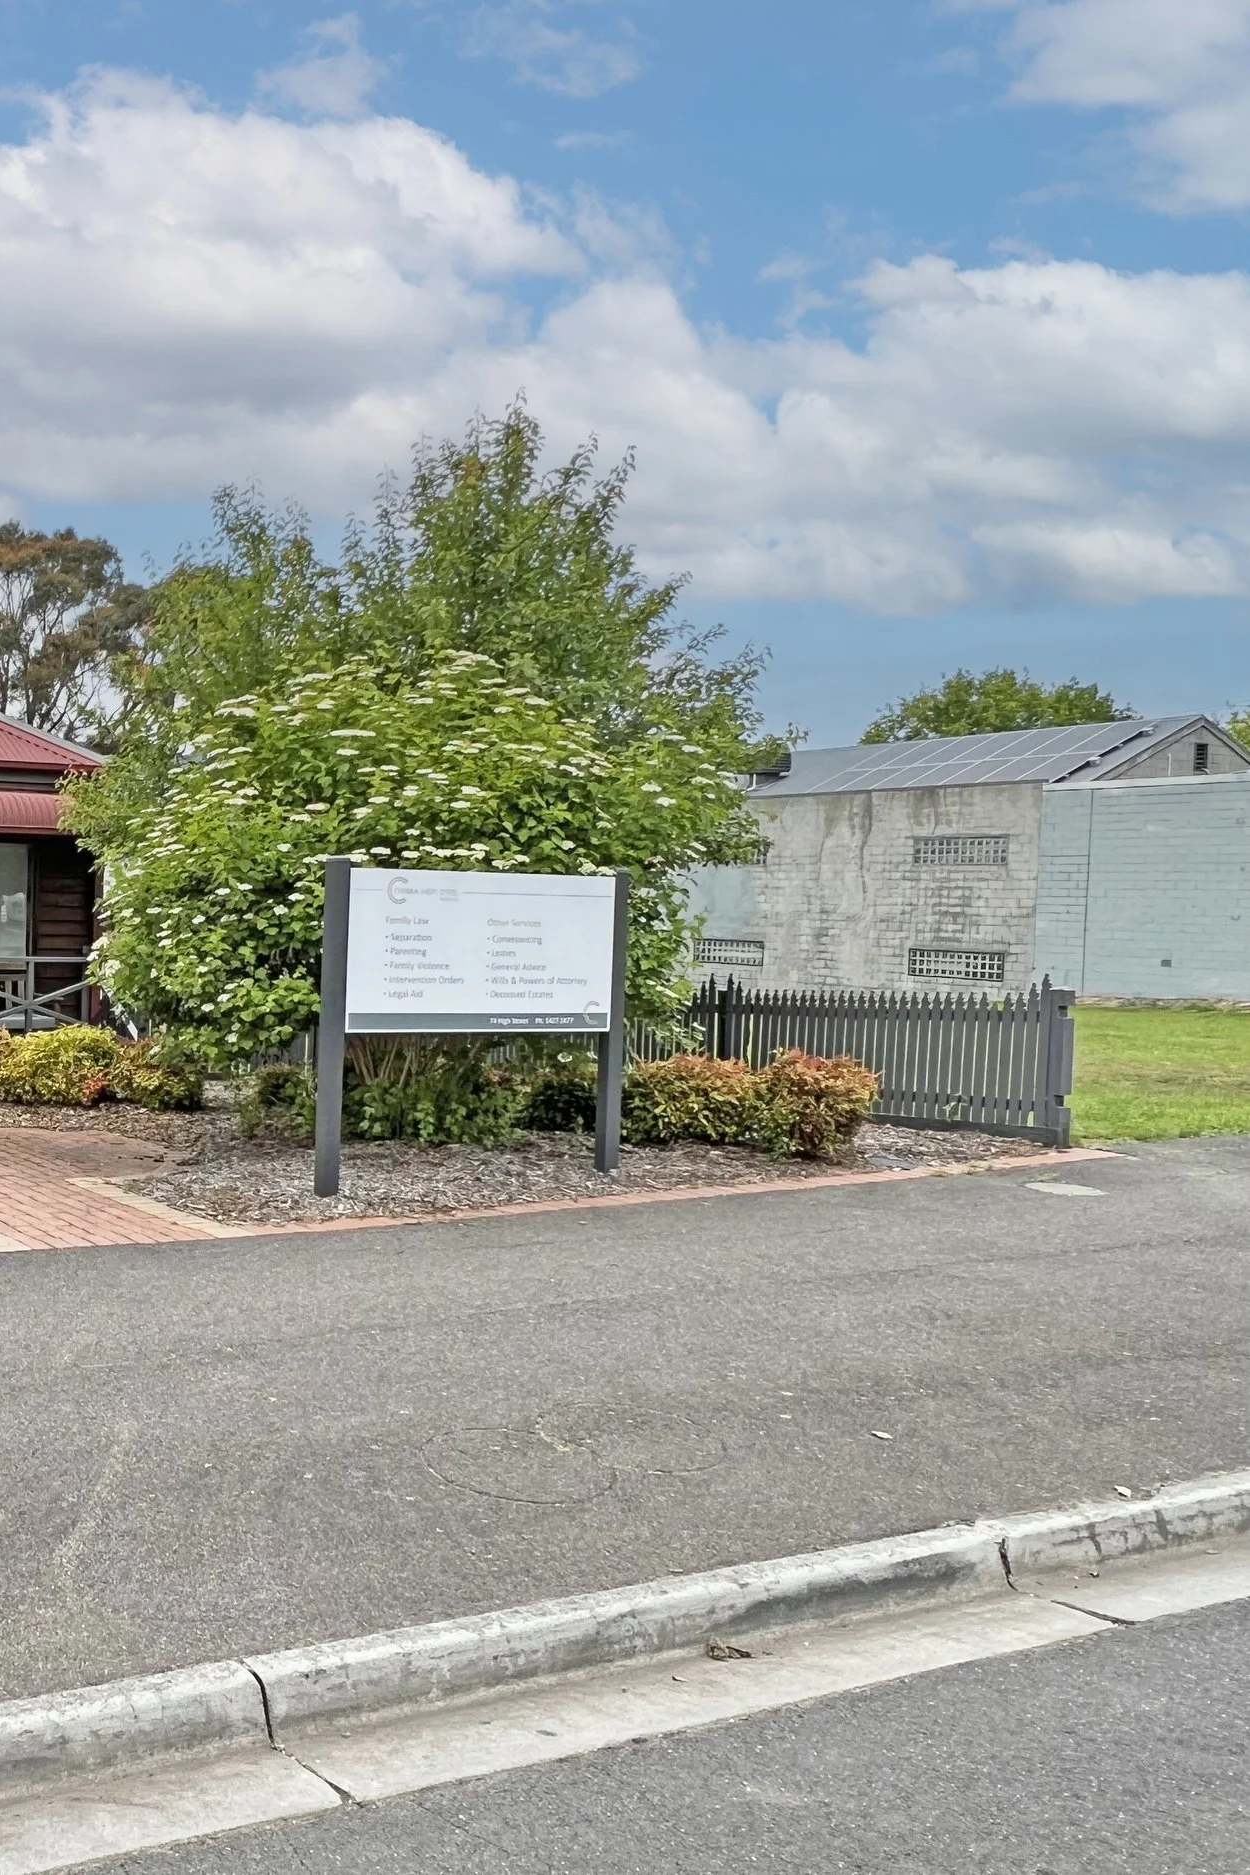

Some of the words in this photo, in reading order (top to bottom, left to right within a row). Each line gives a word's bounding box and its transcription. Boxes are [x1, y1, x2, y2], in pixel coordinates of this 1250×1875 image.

[413, 917, 430, 925] Law
[390, 933, 433, 942] Separation
[390, 947, 427, 958] Parenting
[389, 961, 415, 971] Family
[417, 962, 450, 970] Violence
[491, 963, 520, 971] General
[522, 963, 547, 971] Advice
[389, 976, 437, 984] Intervention
[438, 976, 465, 984] Orders
[491, 976, 509, 985] Wills
[519, 977, 545, 985] Powers
[547, 976, 555, 985] of
[556, 977, 588, 986] Attorney
[388, 989, 409, 1000] Legal
[410, 990, 424, 998] Aid
[528, 990, 554, 999] Estates
